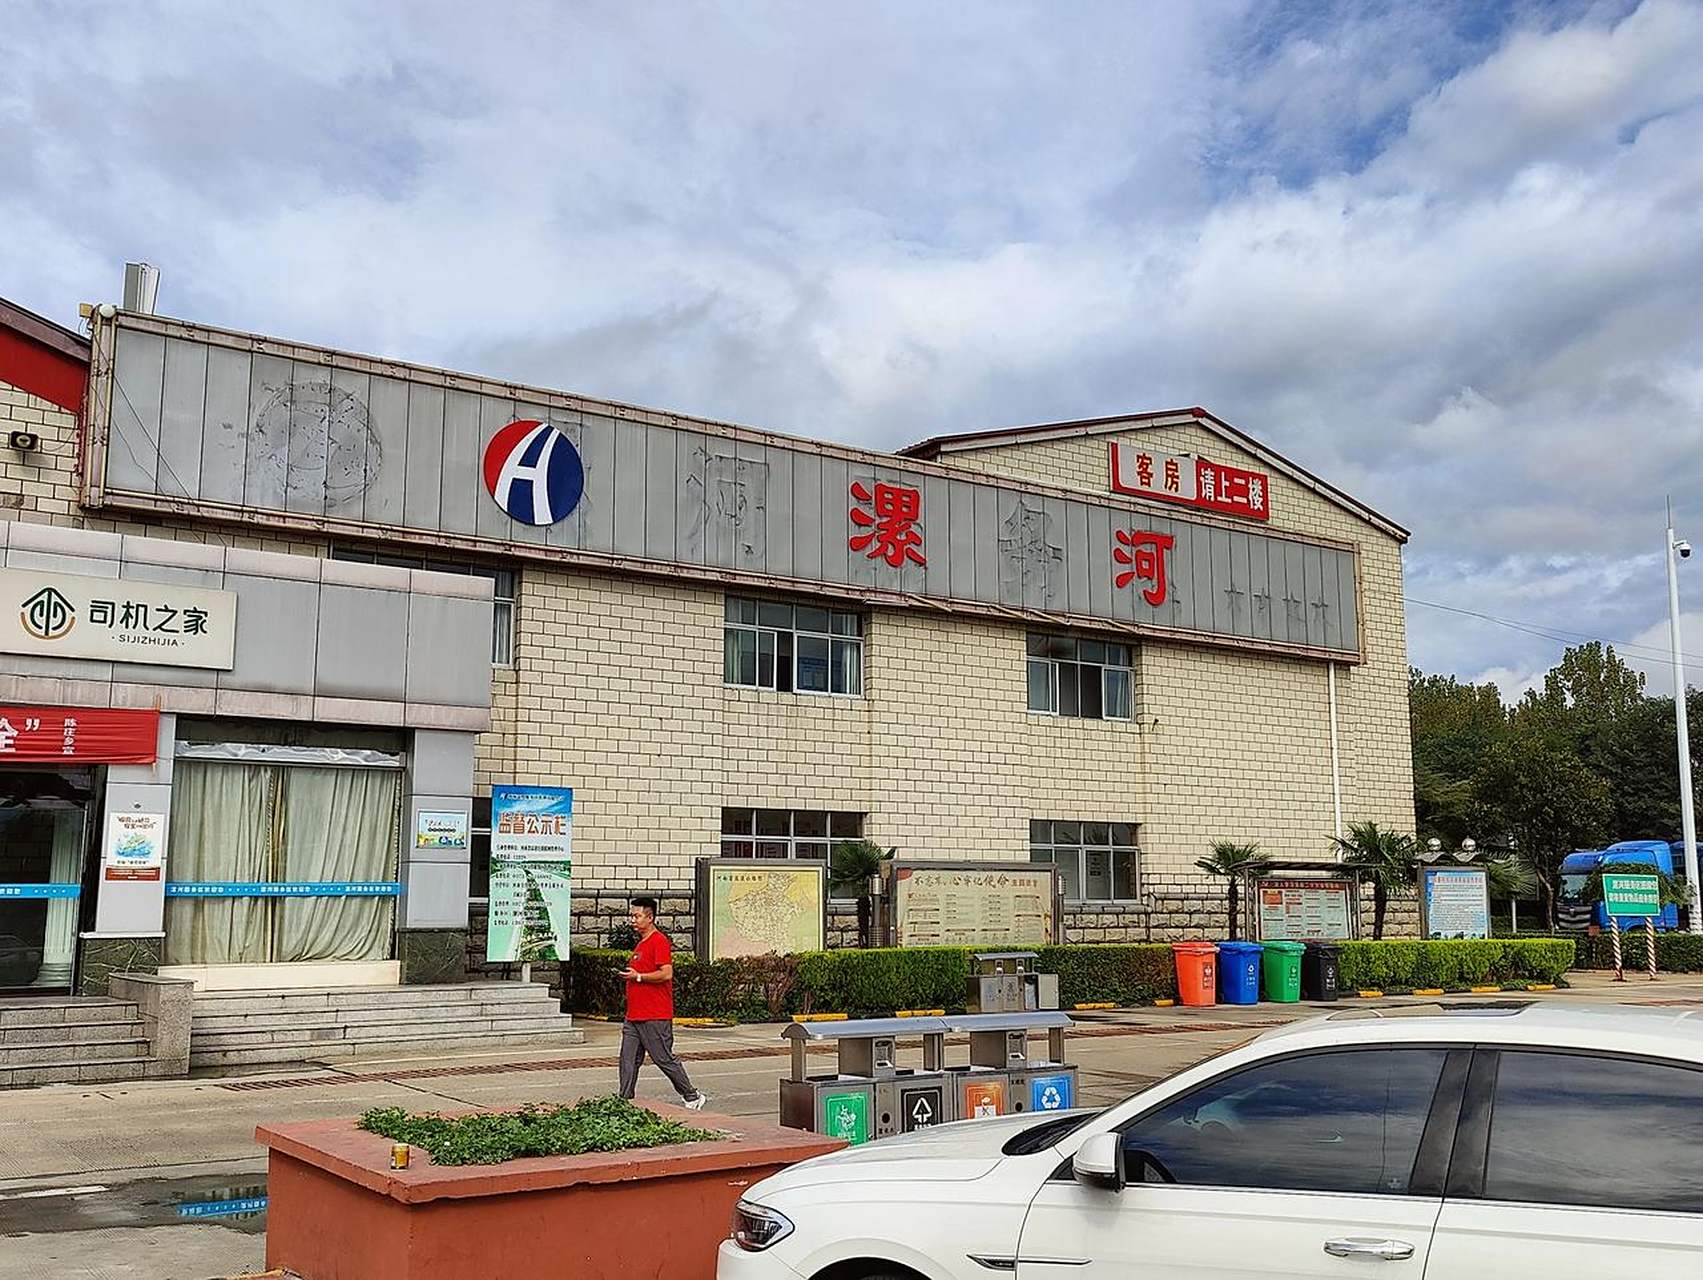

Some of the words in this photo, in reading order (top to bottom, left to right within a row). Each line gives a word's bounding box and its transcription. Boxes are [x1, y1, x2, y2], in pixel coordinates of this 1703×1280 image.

[1136, 452, 1181, 493] 客房
[1200, 467, 1265, 511] 请上二楼
[89, 599, 209, 636] 司机之家
[118, 634, 179, 647] SIJIZHIJIA
[498, 811, 567, 836] 监督公示栏
